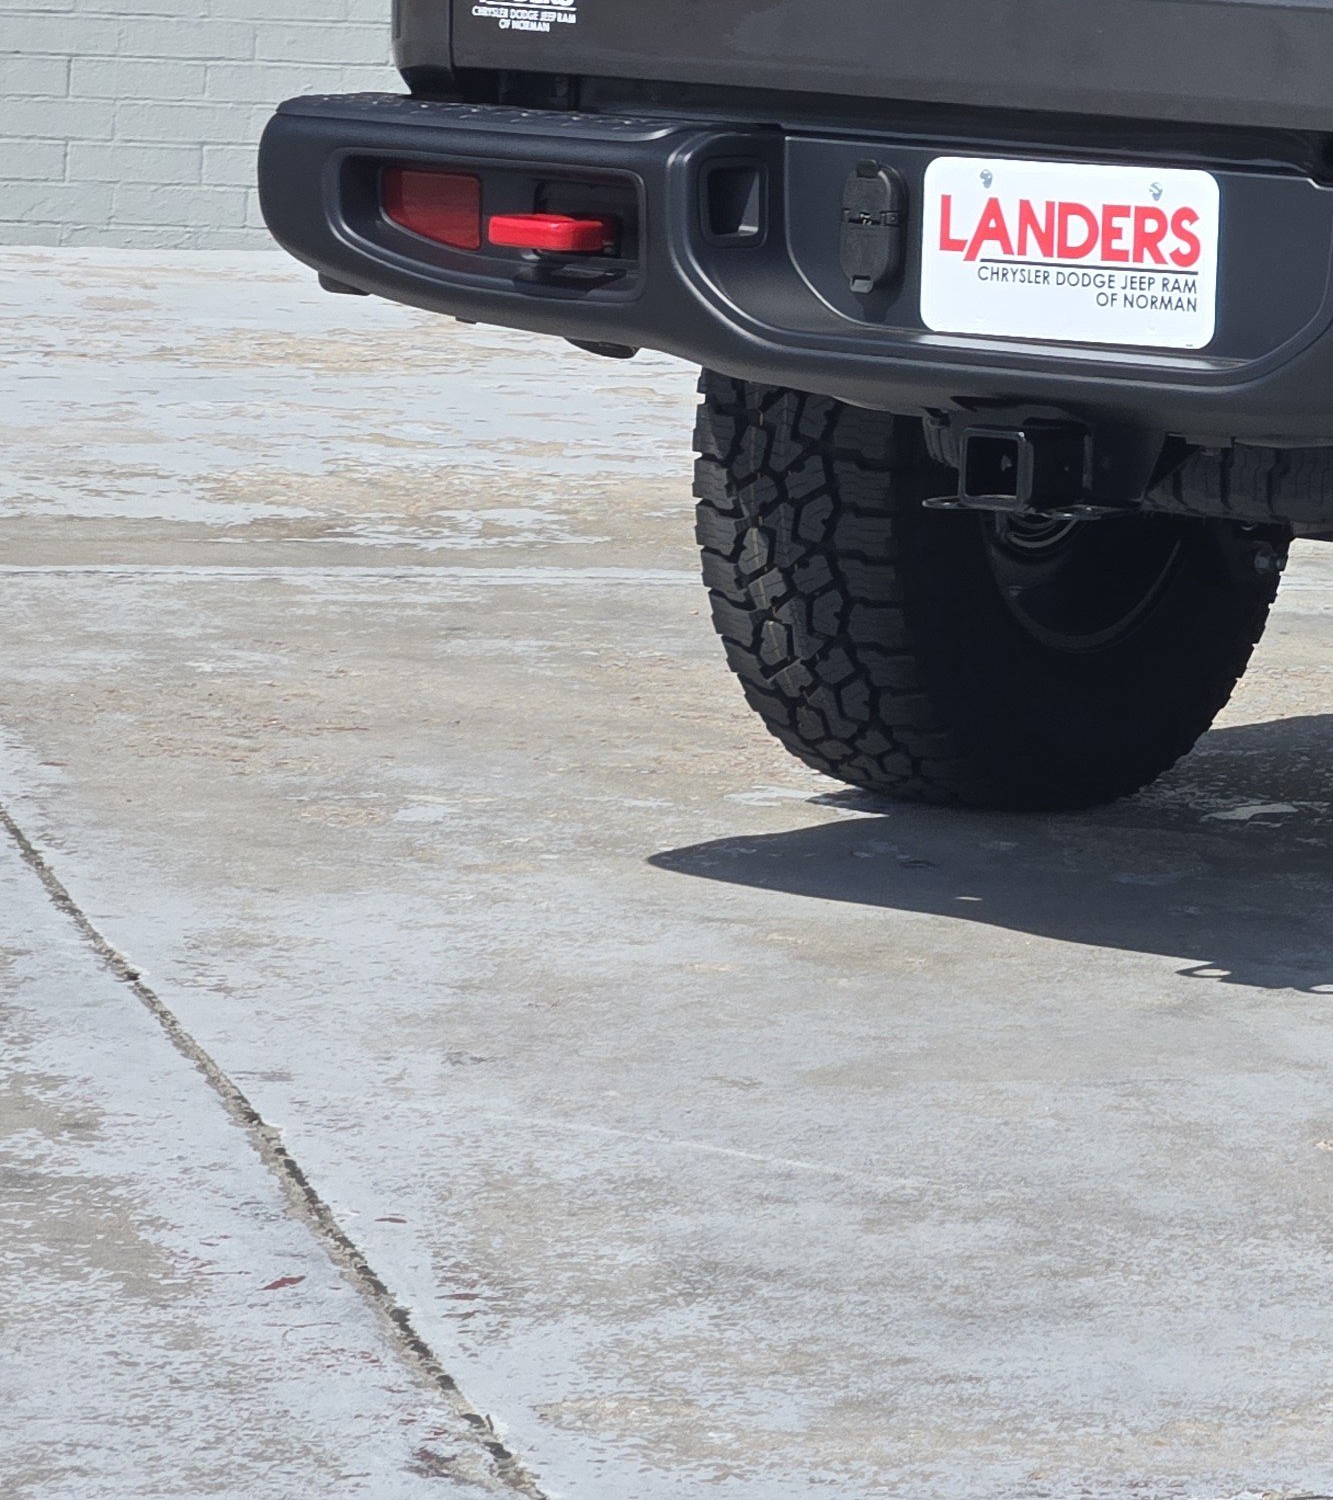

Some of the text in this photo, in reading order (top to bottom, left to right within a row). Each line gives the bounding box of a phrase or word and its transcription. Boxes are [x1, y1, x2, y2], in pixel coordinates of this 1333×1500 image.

[939, 194, 1201, 268] LANDERS
[977, 266, 1197, 294] CHRYSLER DODGE JEEP RAM
[1096, 292, 1197, 312] OF NORMAN
